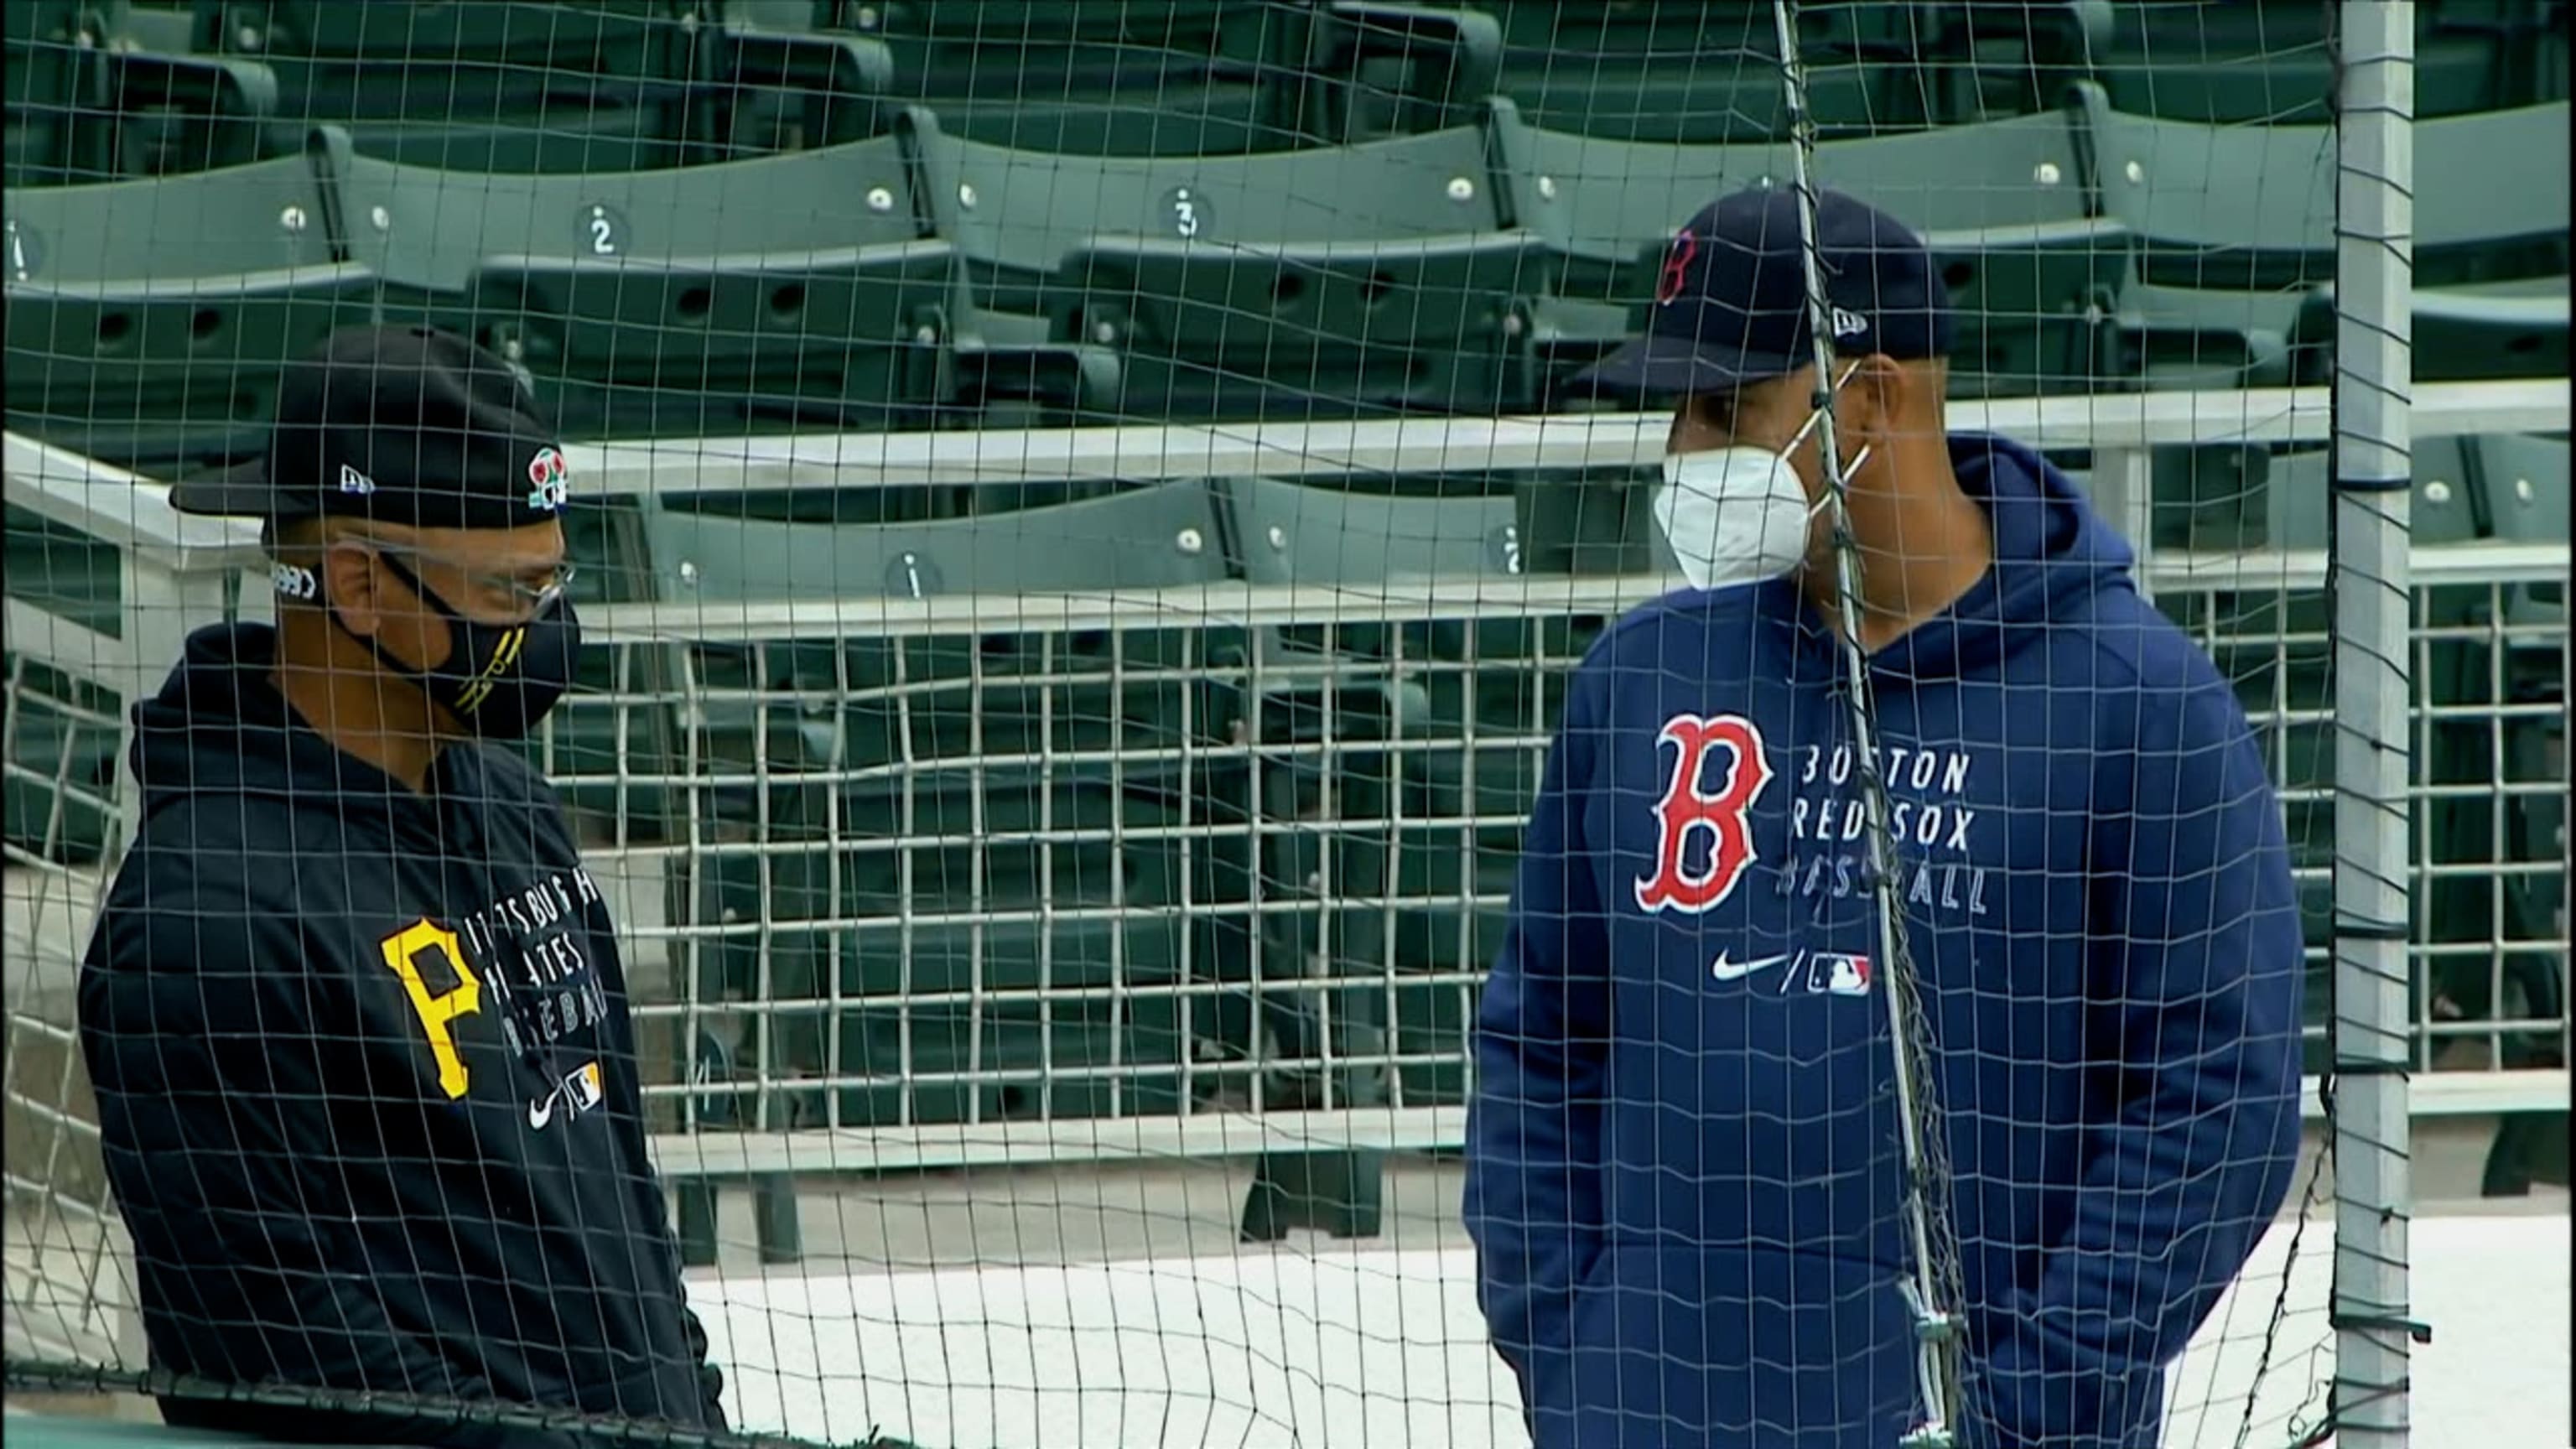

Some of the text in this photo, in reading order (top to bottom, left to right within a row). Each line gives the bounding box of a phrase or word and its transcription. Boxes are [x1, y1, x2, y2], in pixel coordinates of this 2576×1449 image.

[591, 219, 614, 253] 2
[1176, 202, 1197, 236] 3
[1659, 229, 1697, 306] B
[908, 568, 921, 599] 1
[1802, 745, 1969, 793] BOTON
[1634, 713, 1774, 914] B
[1792, 797, 1975, 851] RED SOX
[1776, 854, 1987, 914] BASALL
[485, 932, 584, 1005] PIATES
[382, 918, 481, 1099] P
